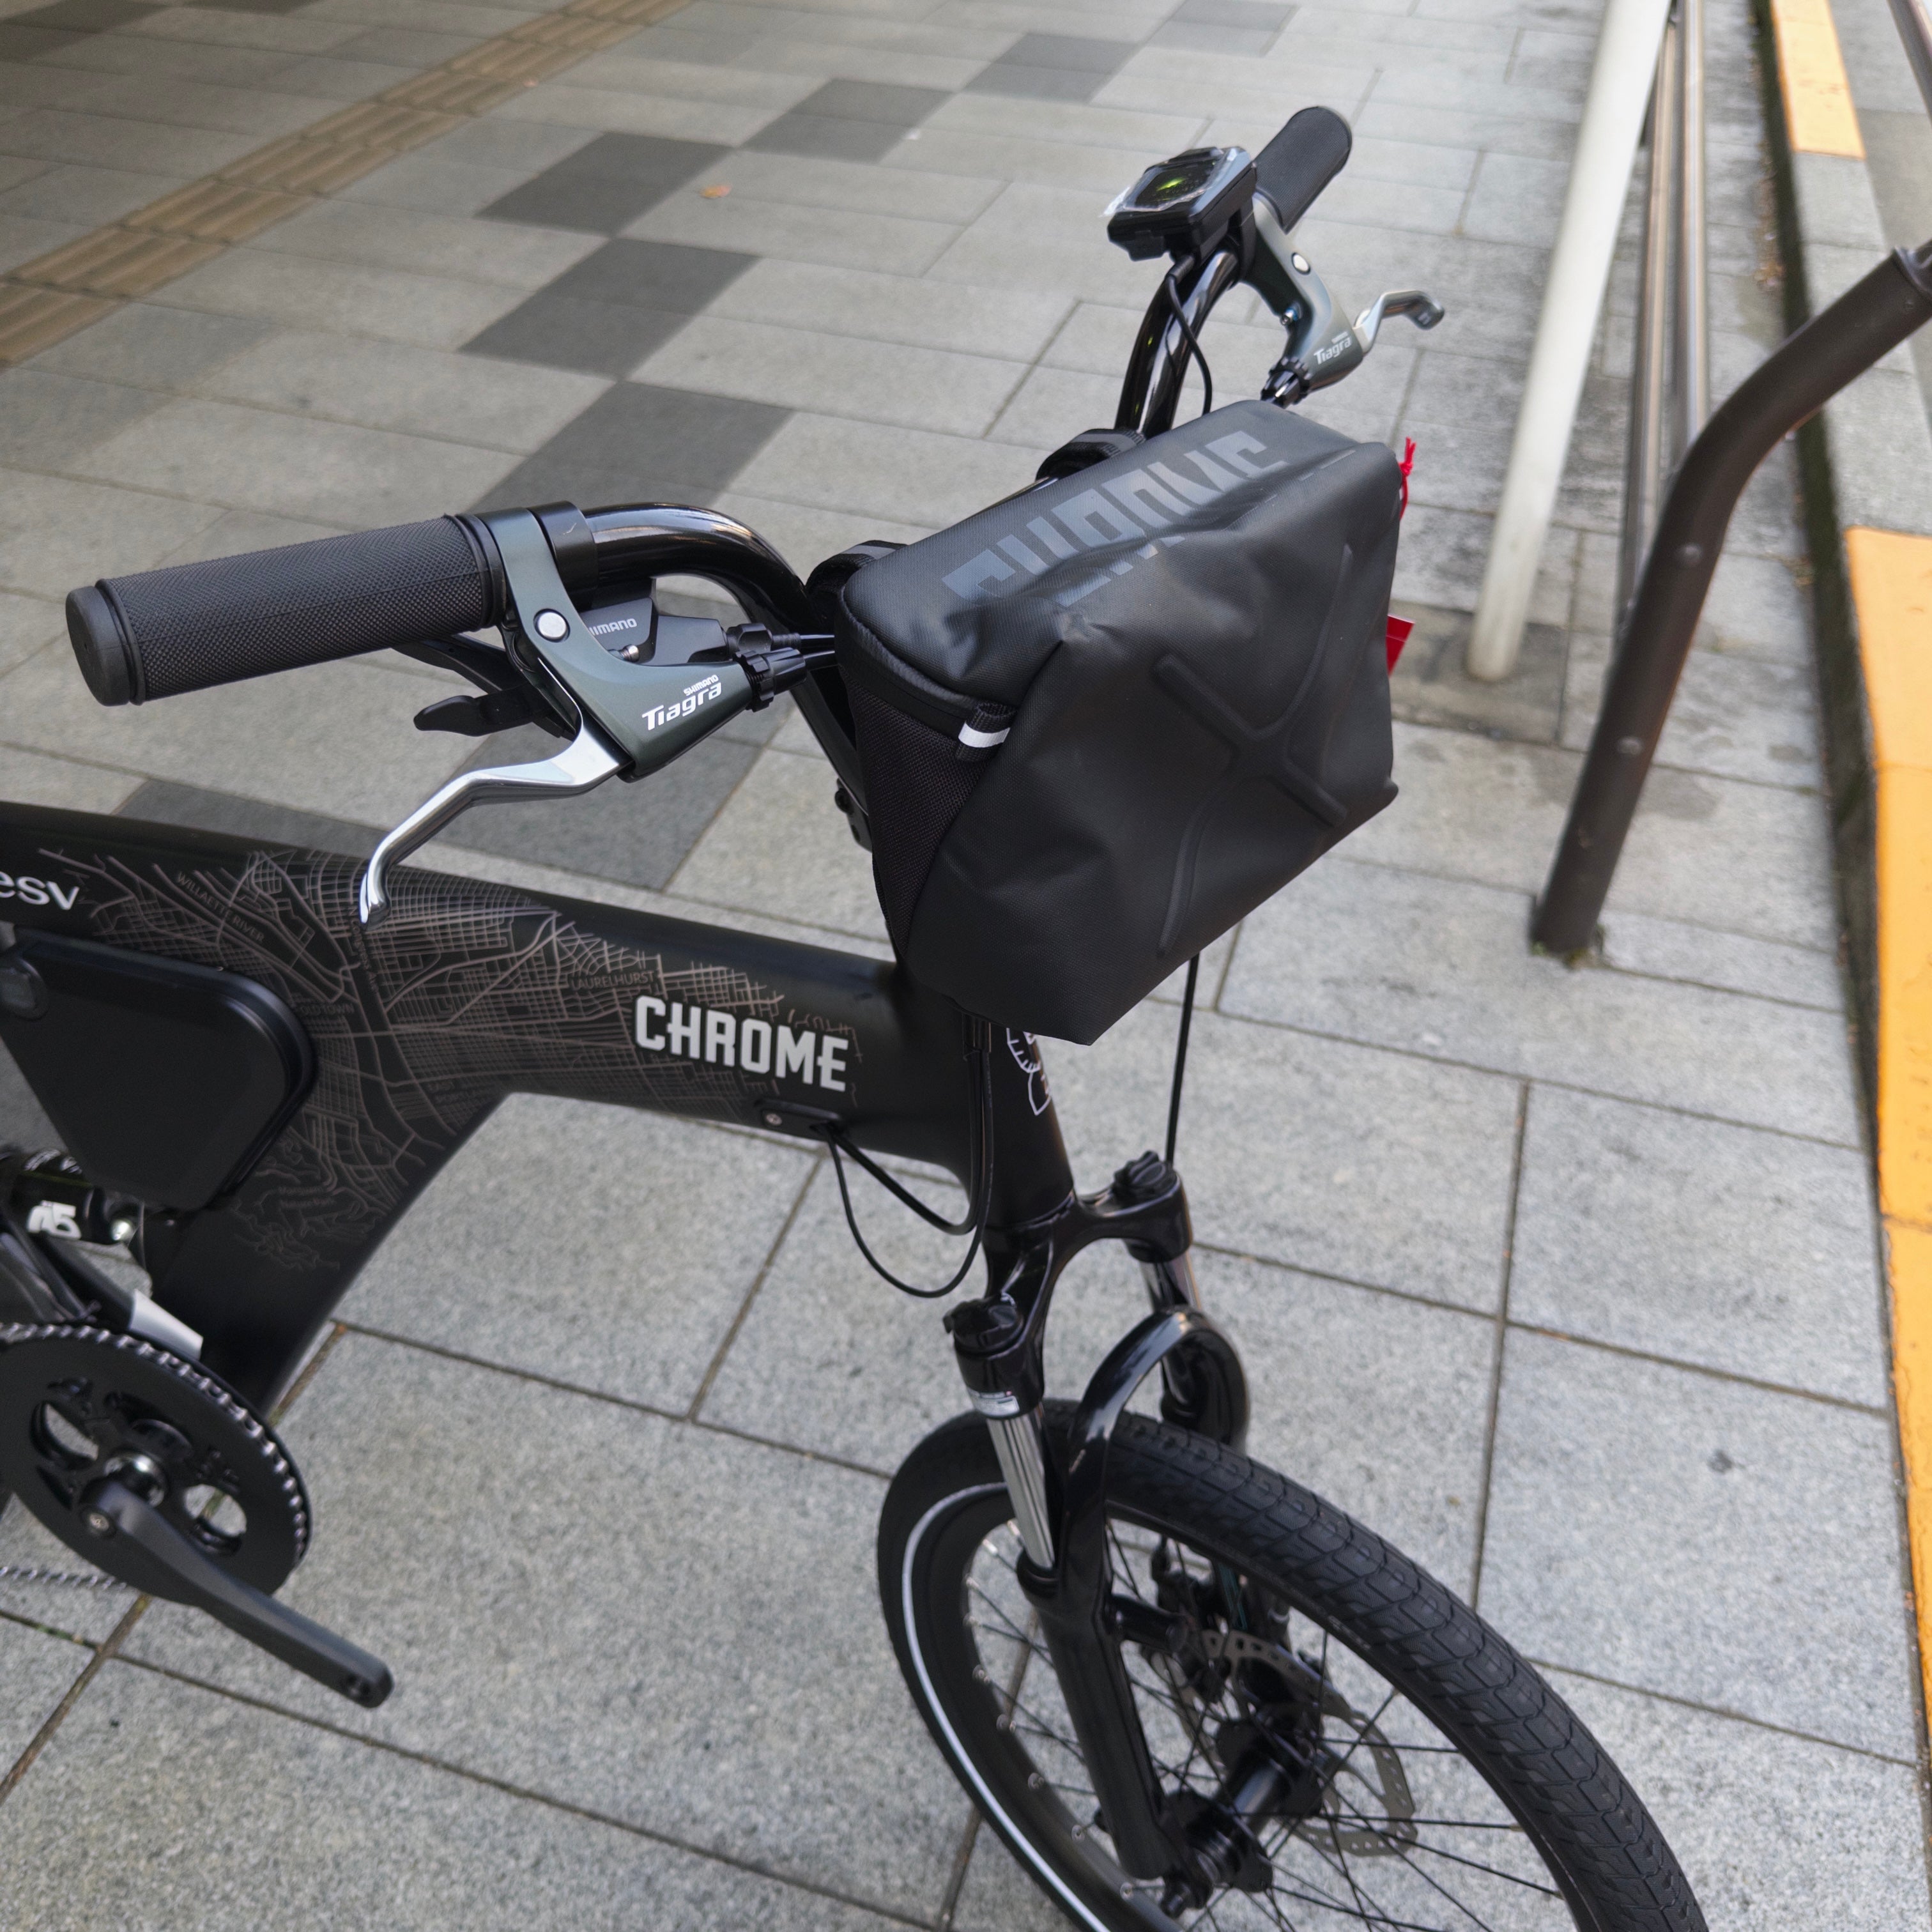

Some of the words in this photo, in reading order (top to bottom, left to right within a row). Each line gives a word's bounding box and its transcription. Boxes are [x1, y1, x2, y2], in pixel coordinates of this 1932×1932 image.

[1314, 337, 1351, 365] Tiagra
[683, 675, 719, 696] SHIMANO
[642, 682, 722, 731] Tiagra
[231, 915, 264, 941] RIVER
[571, 970, 656, 991] LAURELHURST
[634, 995, 849, 1093] CHROME
